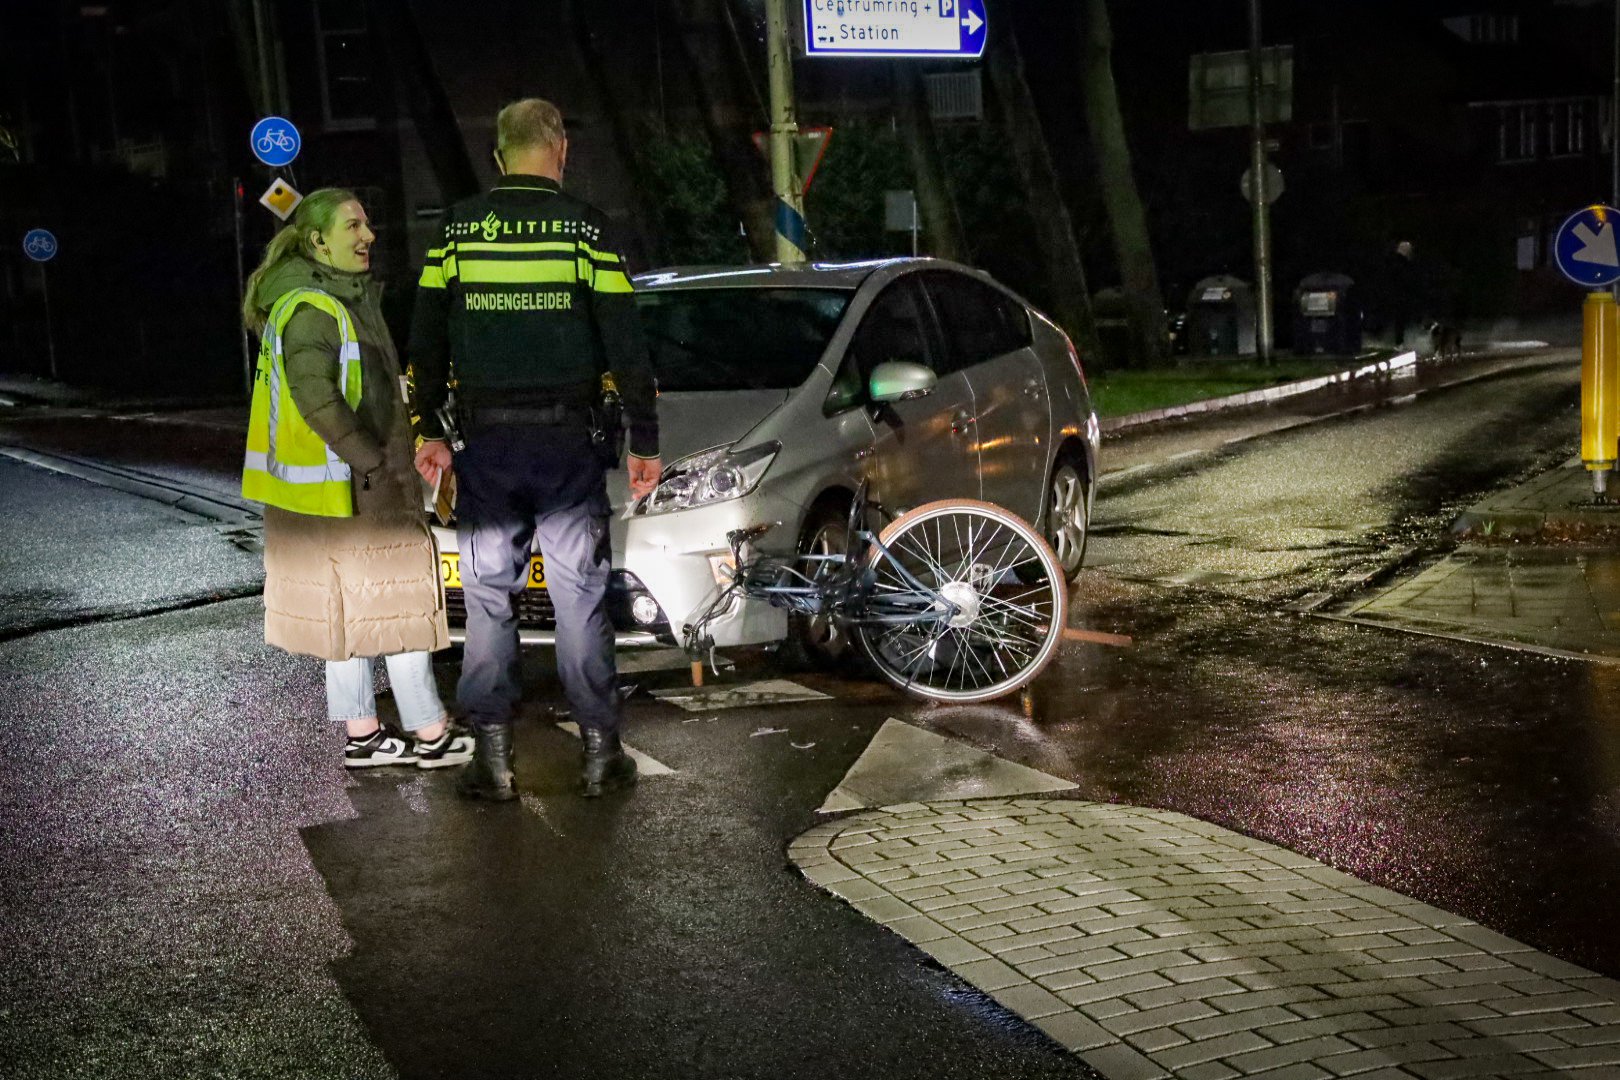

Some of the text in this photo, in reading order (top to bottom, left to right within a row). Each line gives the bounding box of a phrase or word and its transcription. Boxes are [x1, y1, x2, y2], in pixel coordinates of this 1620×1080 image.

[815, 0, 917, 17] Centrumring
[840, 24, 899, 40] Station
[470, 215, 562, 239] POLITIE
[466, 292, 571, 310] HONDENGELEIDER
